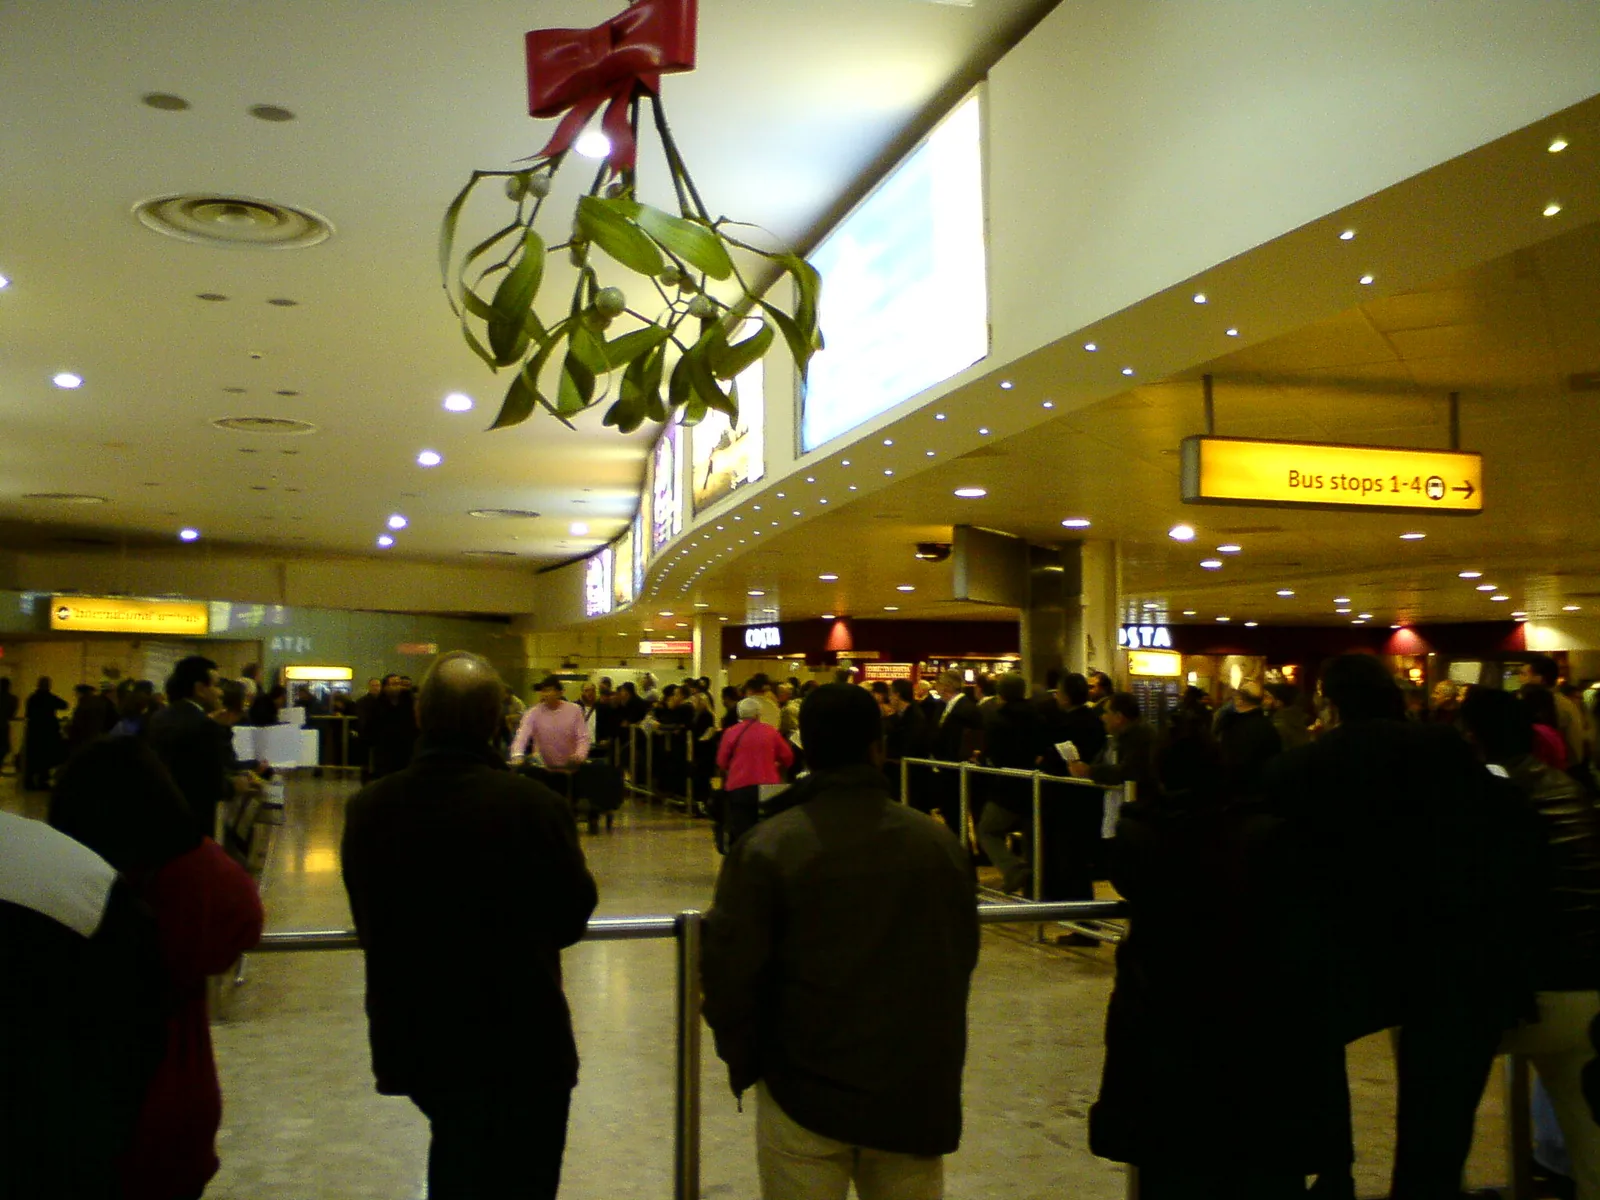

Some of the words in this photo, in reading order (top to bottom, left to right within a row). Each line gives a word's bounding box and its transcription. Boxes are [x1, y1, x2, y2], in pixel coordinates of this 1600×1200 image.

[1289, 469, 1323, 489] Bus
[1330, 474, 1383, 496] stops
[1389, 475, 1422, 493] 1-4
[745, 627, 781, 649] COSTA
